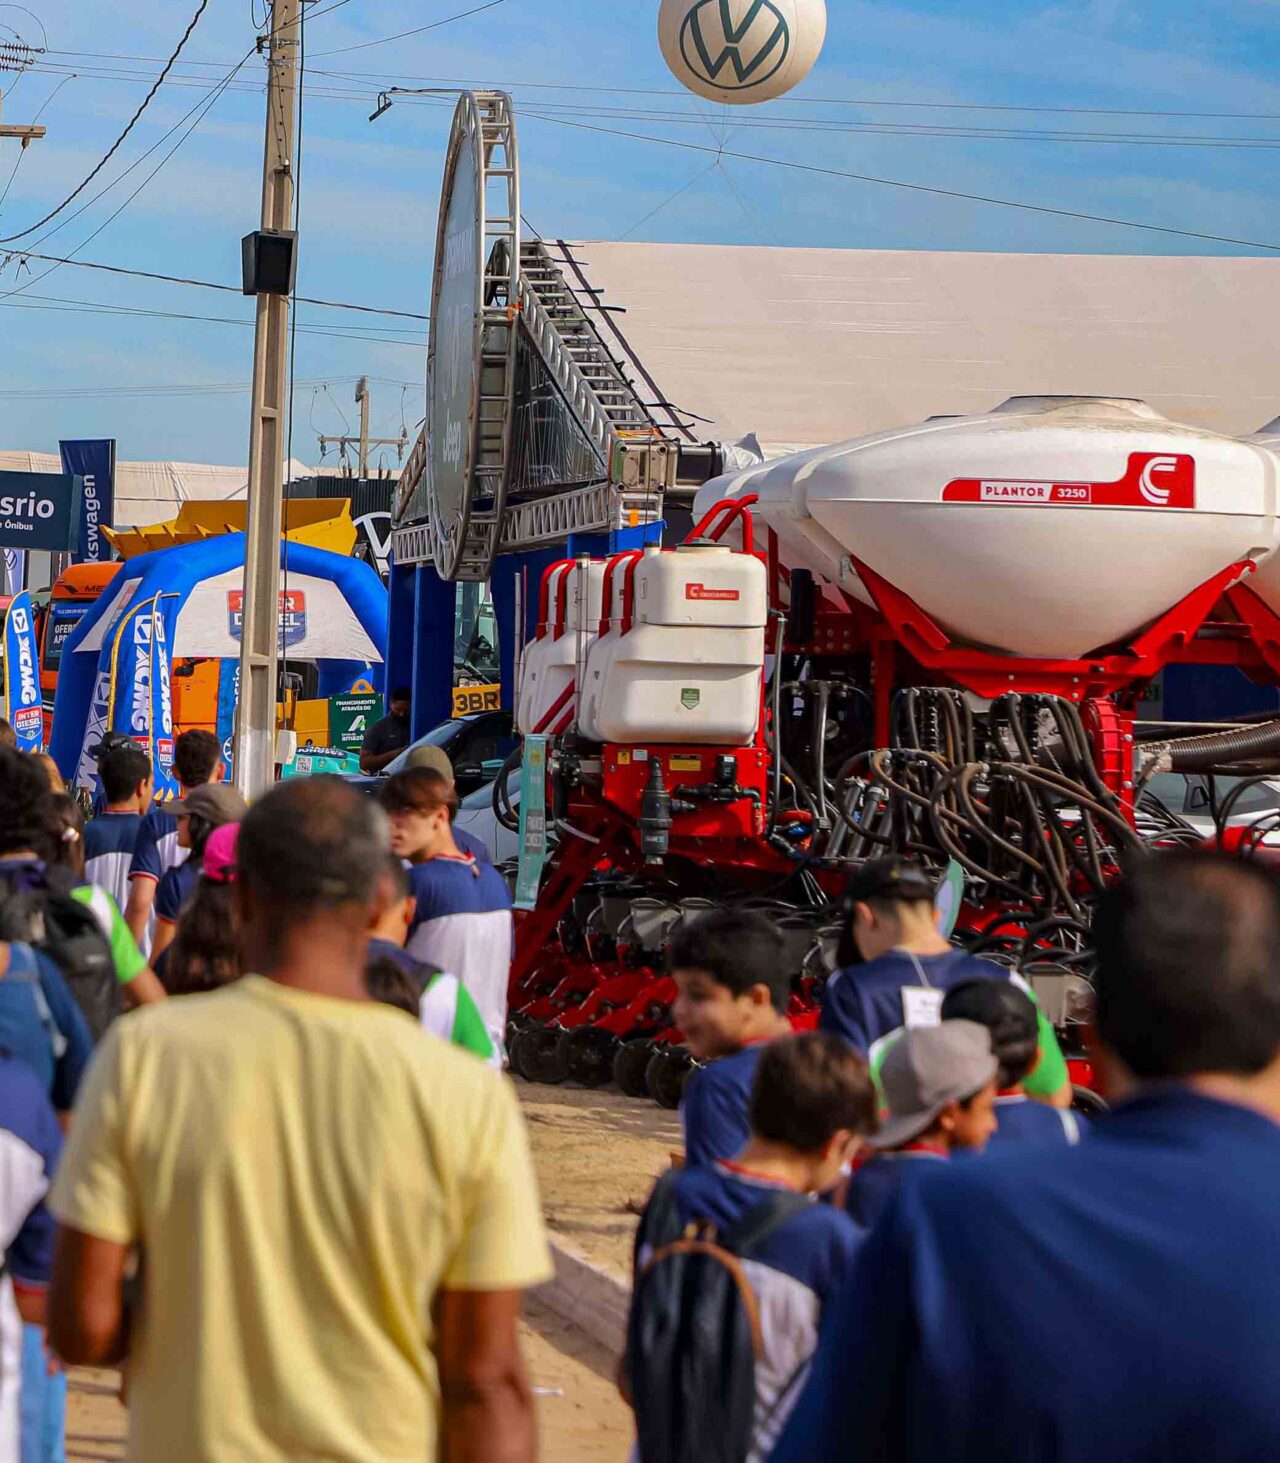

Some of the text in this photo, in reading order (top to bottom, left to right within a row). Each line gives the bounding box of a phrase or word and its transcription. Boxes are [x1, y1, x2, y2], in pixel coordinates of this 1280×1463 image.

[4, 519, 34, 531] Ônibus
[83, 474, 101, 563] kswagen
[985, 486, 1087, 499] PLANTOR 3250
[18, 636, 37, 705] XCMG
[131, 645, 150, 732] XCMG
[158, 643, 173, 735] XCMG
[455, 692, 499, 712] 3BR
